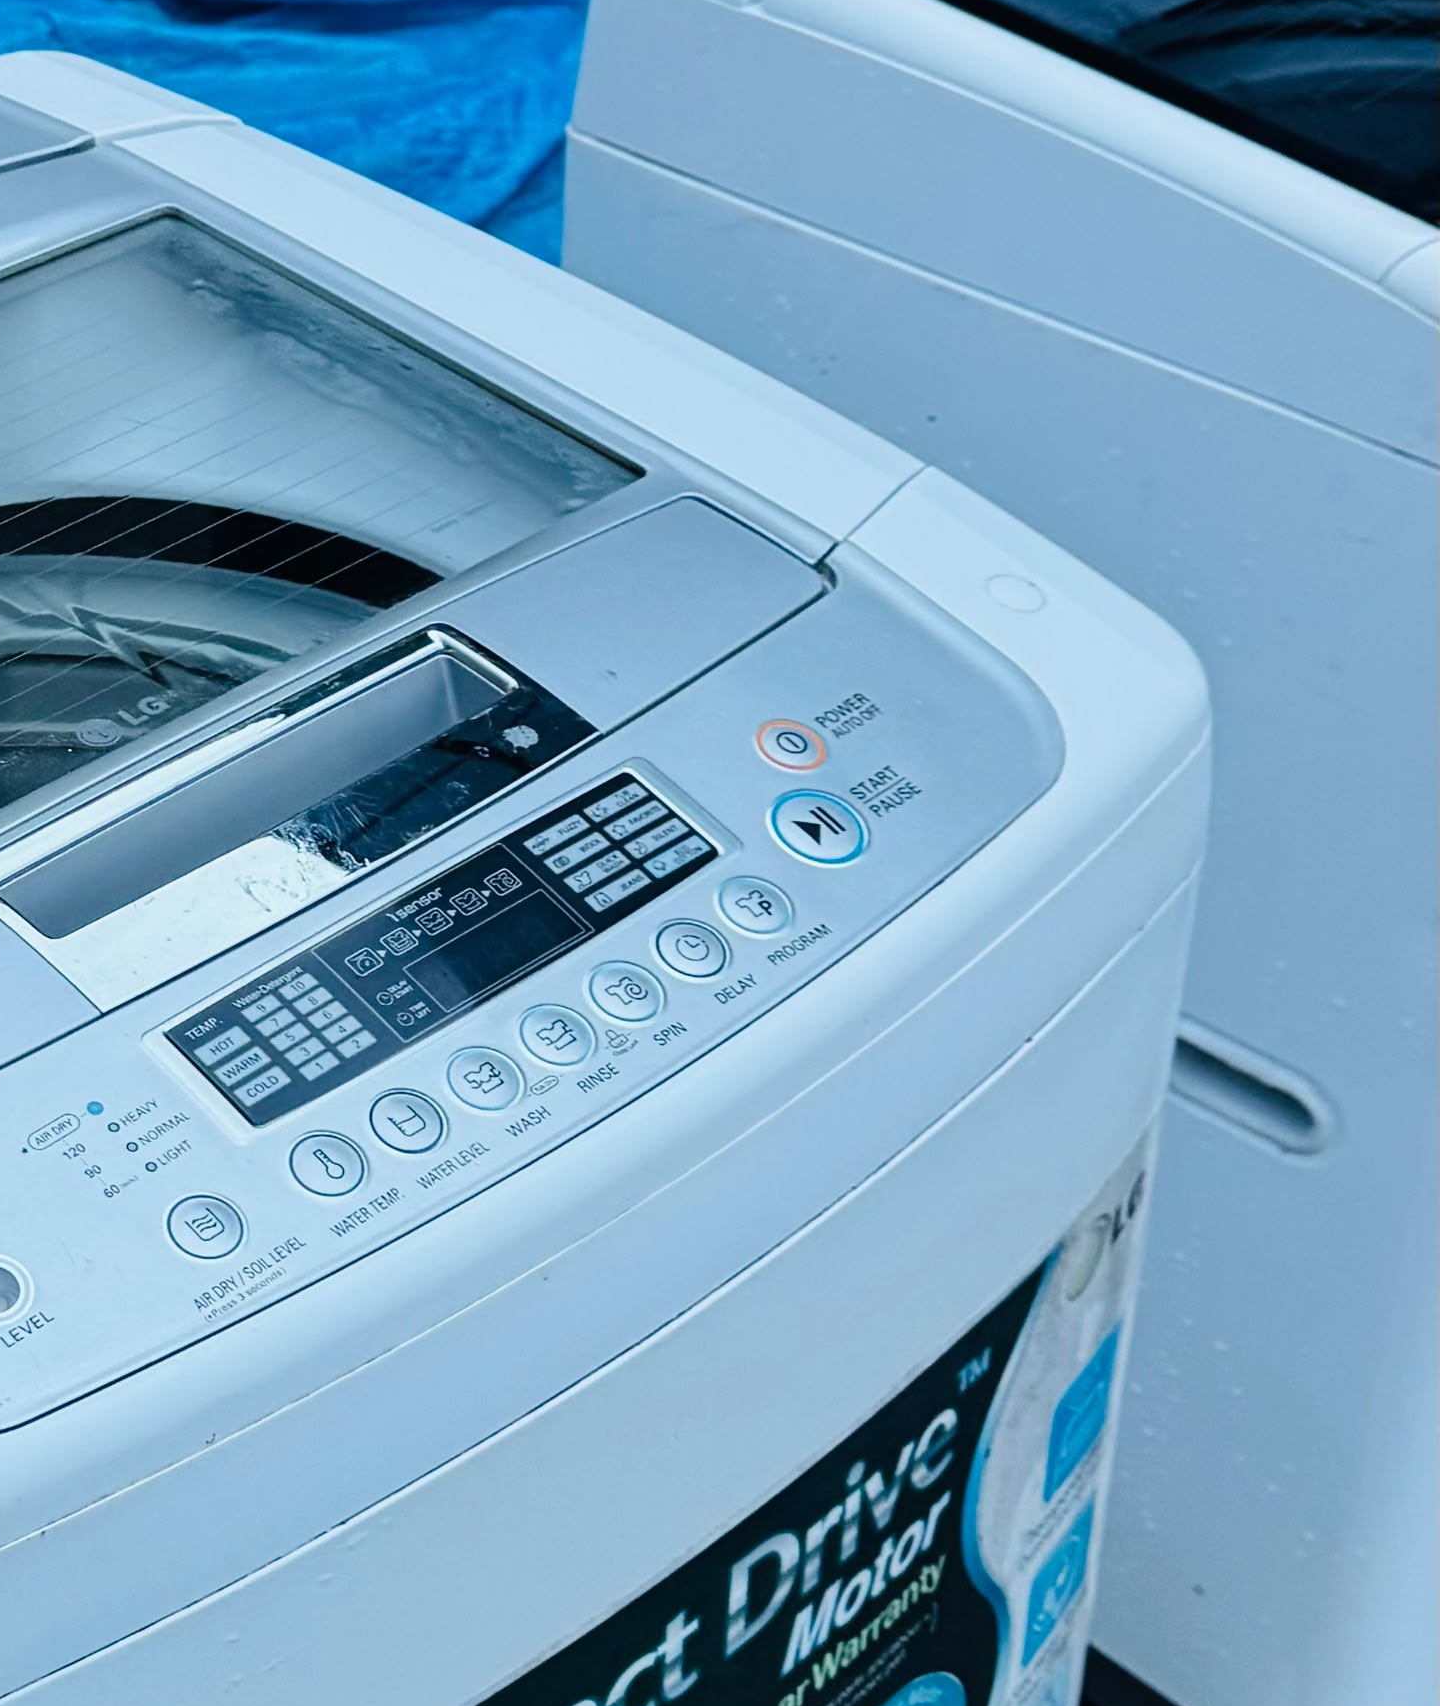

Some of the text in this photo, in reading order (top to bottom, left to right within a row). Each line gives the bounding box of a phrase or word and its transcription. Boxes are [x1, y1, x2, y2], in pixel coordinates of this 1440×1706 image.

[117, 696, 171, 726] LG
[814, 693, 871, 729] POWER
[831, 714, 864, 739] AUTO
[849, 765, 899, 800] START
[868, 781, 923, 817] PAUSE
[558, 819, 582, 836] FUZZY
[767, 923, 834, 966] PROGRAM
[290, 980, 306, 993] 10
[307, 995, 319, 1006] 8
[714, 973, 759, 1006] DELAY
[184, 1015, 224, 1041] TEMP.
[271, 1010, 333, 1028] 7 6
[285, 1025, 348, 1042] 5 4
[210, 1035, 236, 1057] HOT
[652, 1021, 688, 1048] SPIN
[221, 1052, 264, 1080] WARM
[300, 1046, 311, 1057] 3
[314, 1061, 324, 1071] 1
[245, 1074, 280, 1098] COLD
[576, 1062, 620, 1094] RINSE
[119, 1098, 159, 1127] HEAVY
[505, 1105, 553, 1139] WASH
[34, 1117, 75, 1146] AIR DRY
[138, 1112, 192, 1146] NORMAL
[62, 1142, 86, 1160] 120
[157, 1139, 193, 1166] LIGHT
[416, 1141, 491, 1190] WATER LEVEL
[84, 1164, 102, 1178] 90
[103, 1184, 120, 1198] 60
[329, 1206, 371, 1238] WATER
[193, 1291, 217, 1312] AIR
[211, 1275, 239, 1299] DRY
[242, 1257, 273, 1280] SOIL
[268, 1236, 307, 1263] LEVEL
[0, 1310, 55, 1349] LEVEL
[722, 1407, 957, 1661] Drive
[779, 1490, 954, 1678] Motor
[811, 1554, 947, 1691] Warranty
